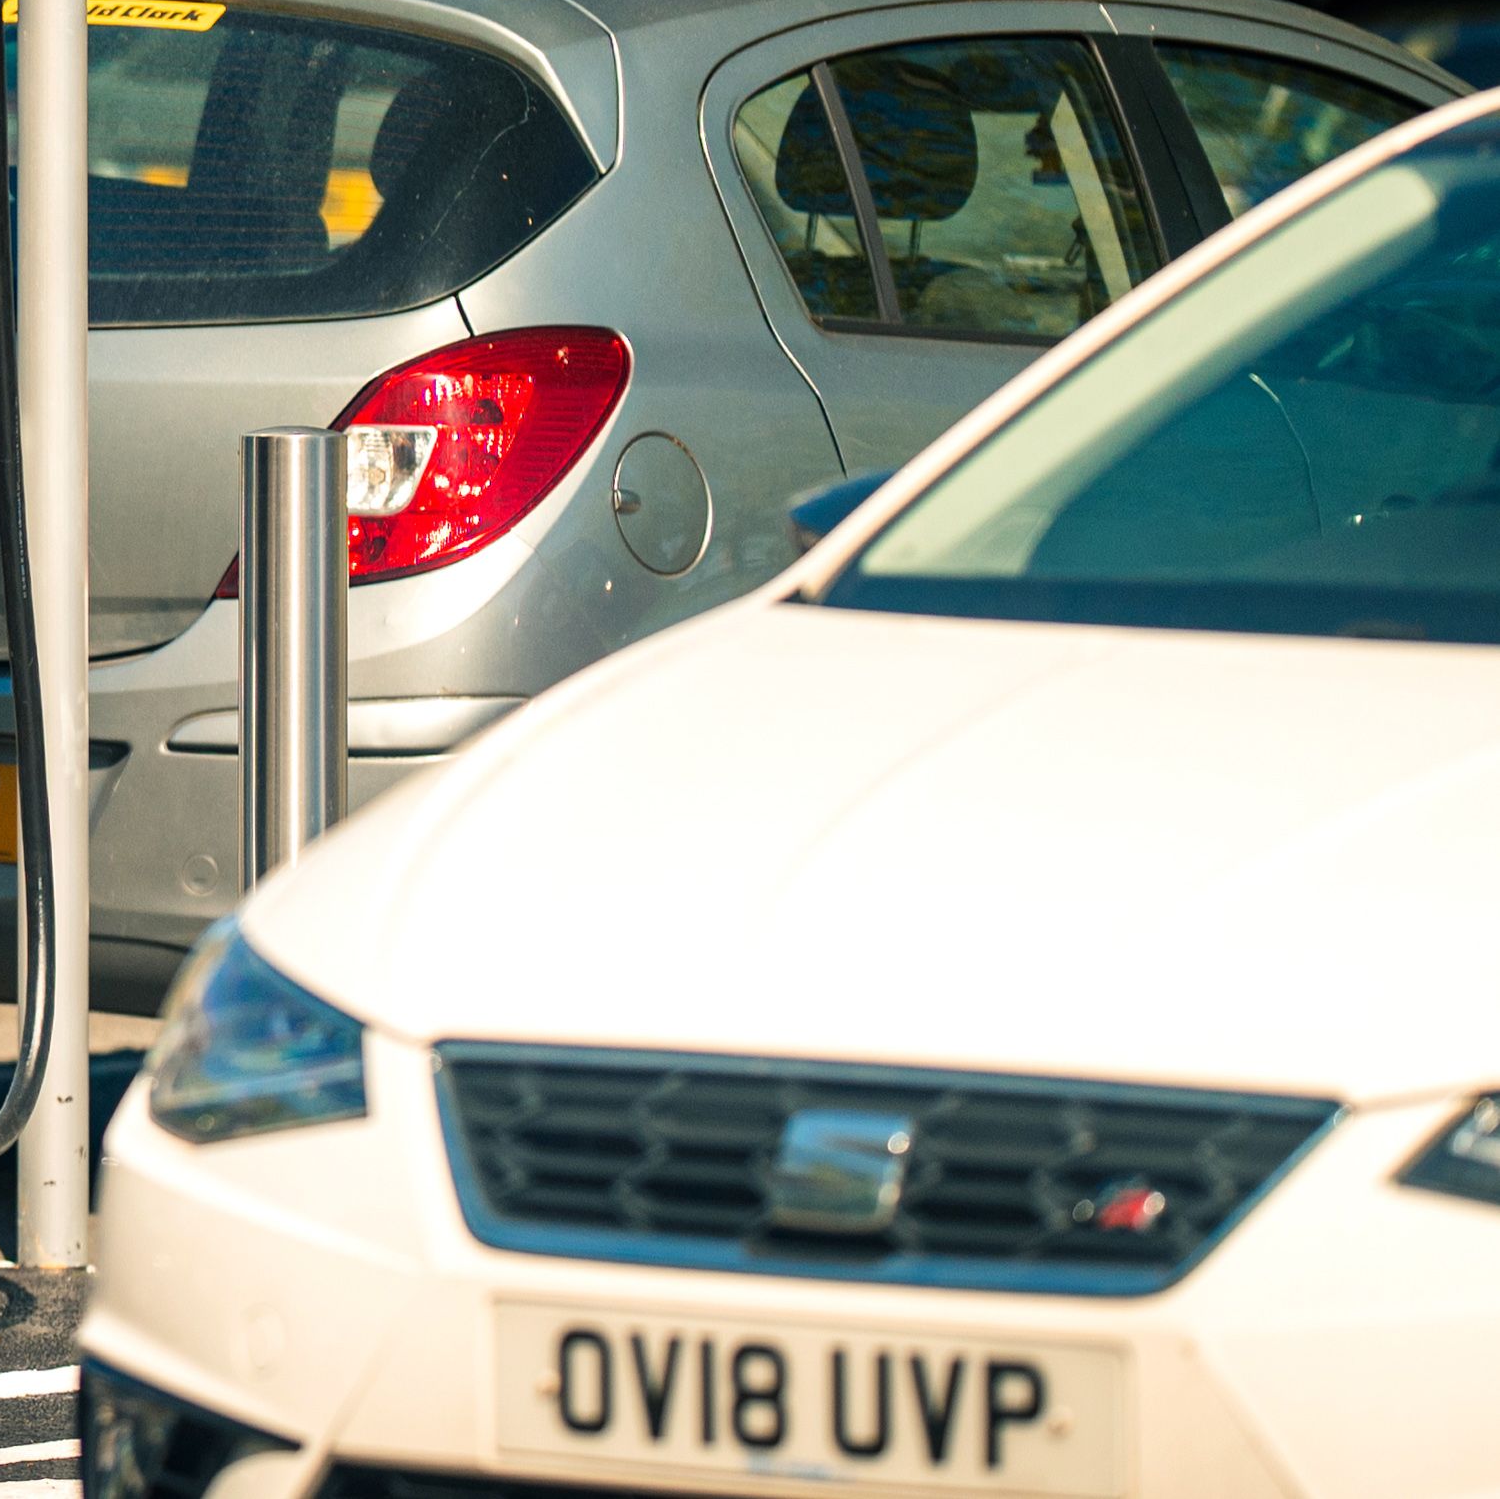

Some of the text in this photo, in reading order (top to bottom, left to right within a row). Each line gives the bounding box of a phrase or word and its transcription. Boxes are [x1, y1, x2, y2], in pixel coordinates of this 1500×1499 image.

[123, 6, 206, 22] Clark
[557, 1327, 1046, 1469] OV18 UVP
